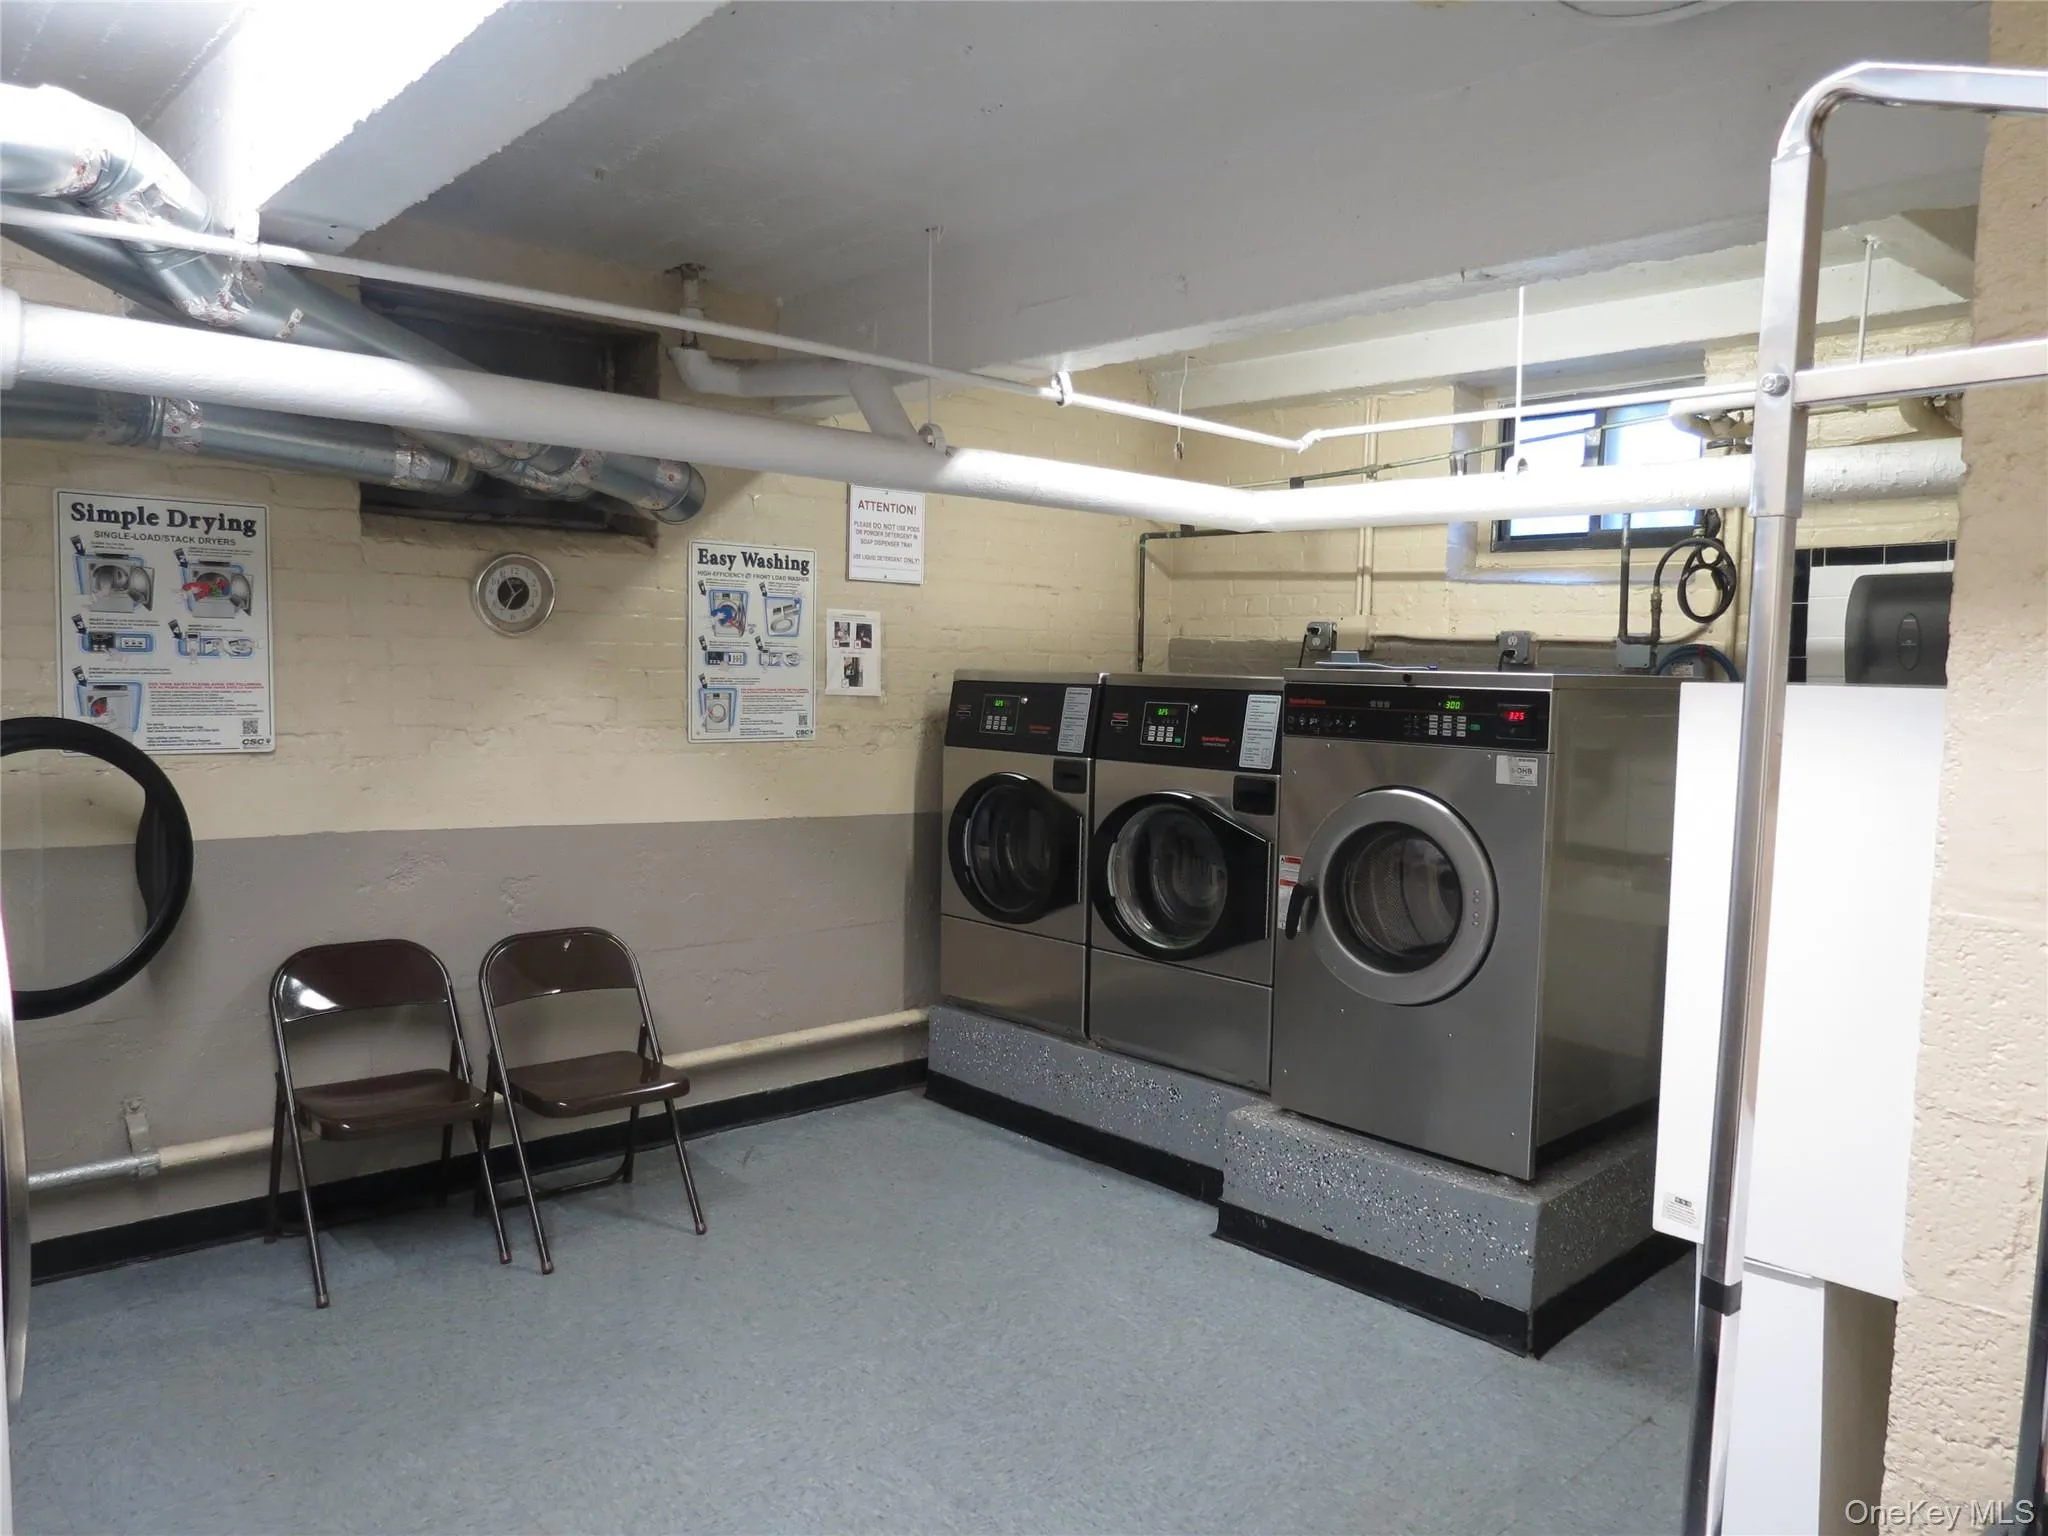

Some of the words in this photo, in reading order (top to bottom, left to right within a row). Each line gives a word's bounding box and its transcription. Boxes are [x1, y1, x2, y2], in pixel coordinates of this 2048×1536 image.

[858, 500, 917, 515] ATTENTION!
[70, 502, 160, 530] Simple
[166, 509, 257, 537] Drying
[94, 530, 195, 544] SINGLE-LOAD/STACK
[198, 537, 236, 546] DRYERS
[884, 531, 912, 539] DETERGENT
[874, 540, 899, 548] DISPENSER
[697, 548, 736, 571] Easy
[741, 552, 809, 576] Washing
[1445, 701, 1461, 710] 300
